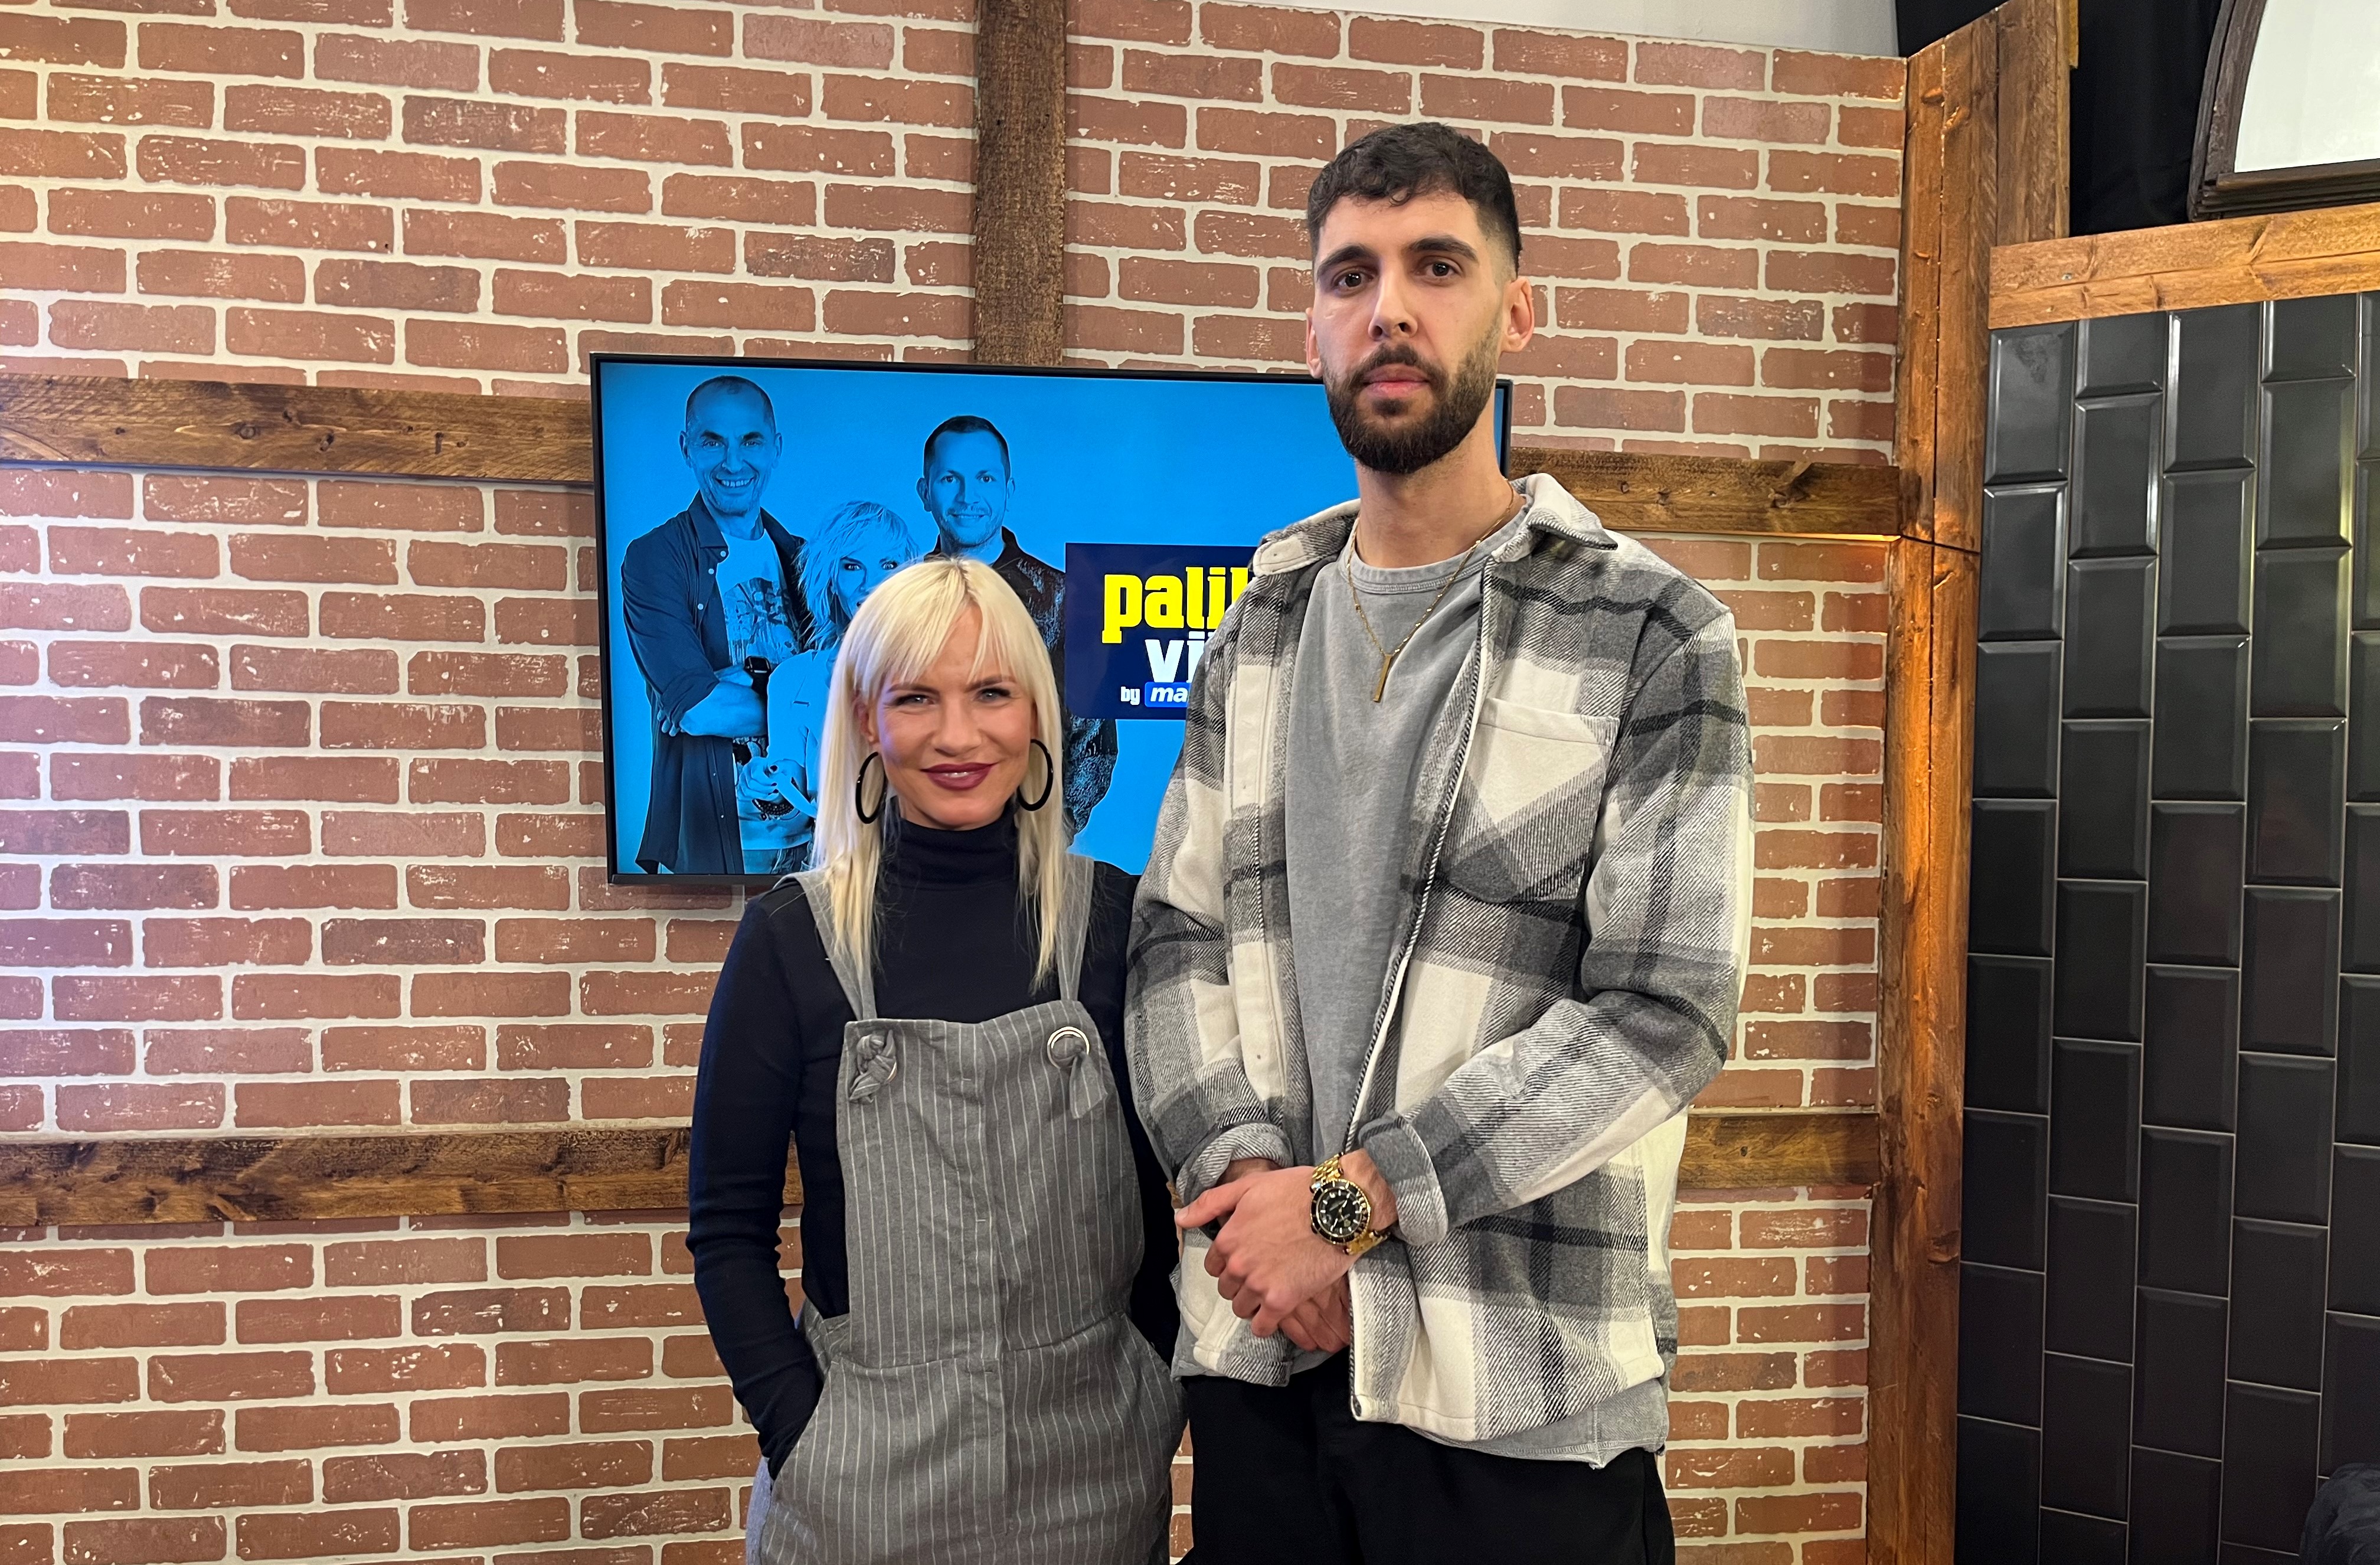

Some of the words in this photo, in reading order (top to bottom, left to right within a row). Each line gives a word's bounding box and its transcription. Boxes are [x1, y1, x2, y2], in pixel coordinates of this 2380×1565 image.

[1145, 631, 1215, 683] vi
[1120, 687, 1140, 705] by
[1150, 687, 1188, 703] ma
